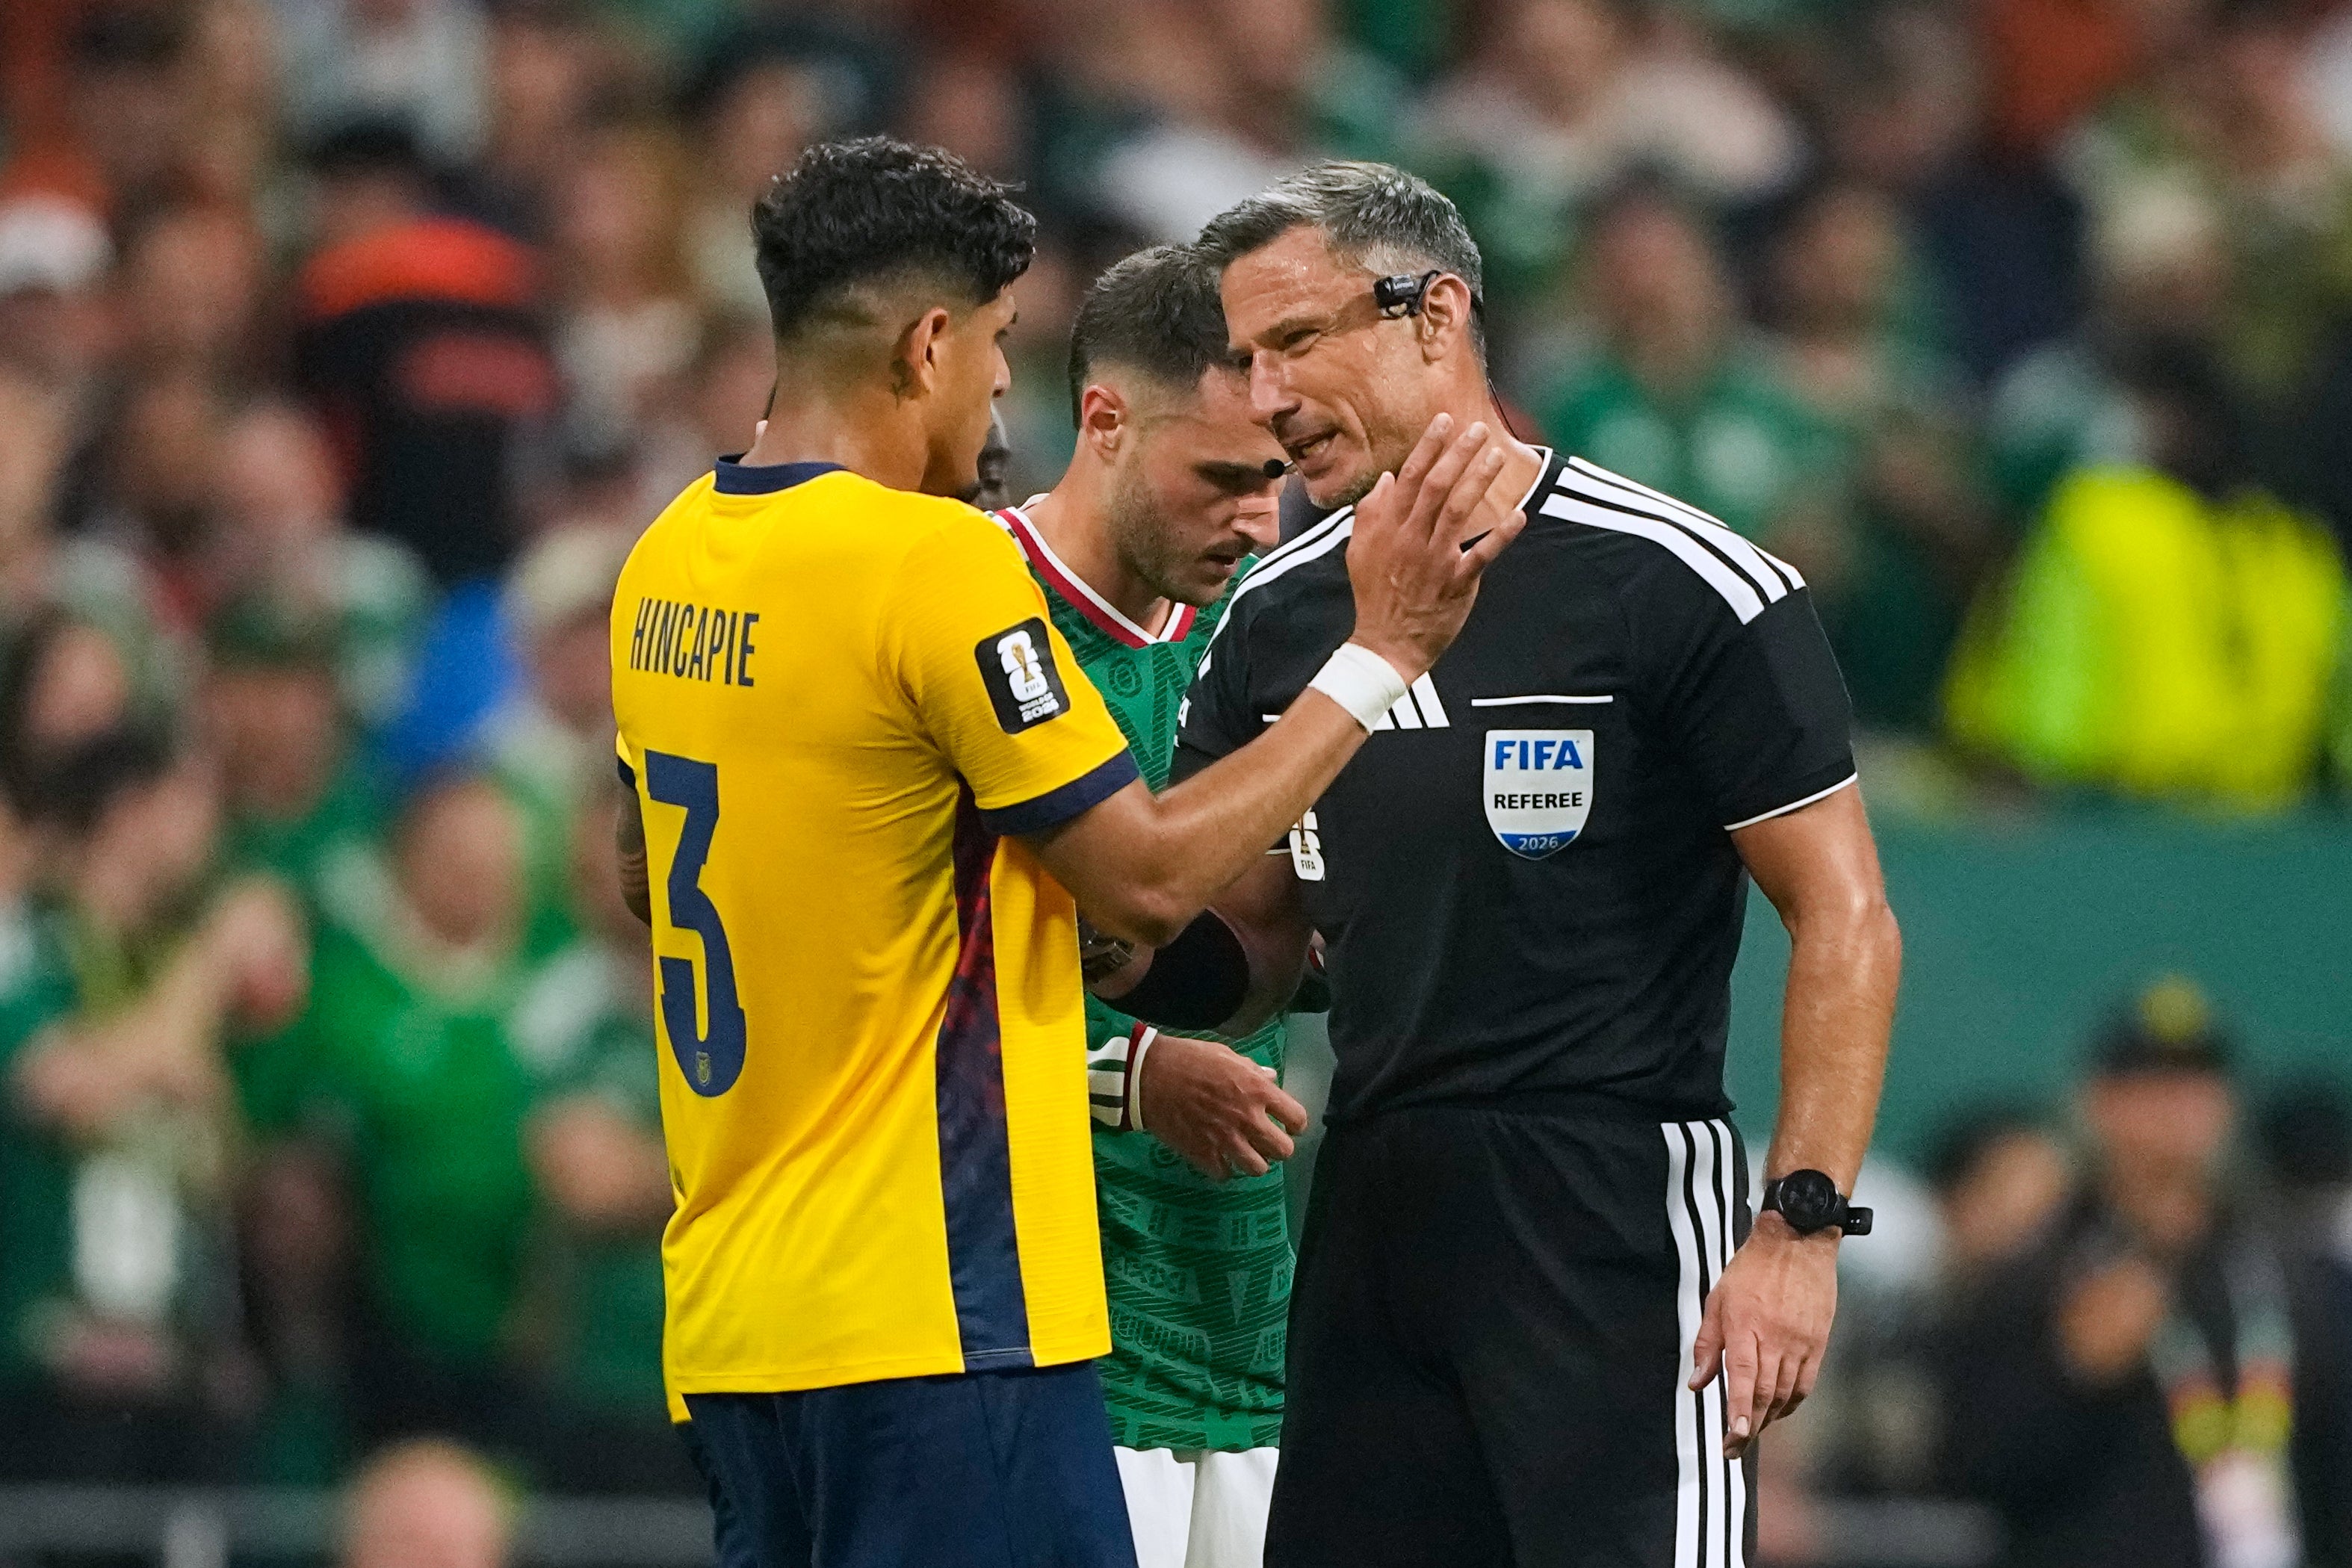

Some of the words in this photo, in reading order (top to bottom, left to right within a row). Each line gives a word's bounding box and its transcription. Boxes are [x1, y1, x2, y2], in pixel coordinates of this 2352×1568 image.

[631, 597, 759, 687] HINCAPIE
[1495, 740, 1583, 770] FIFA
[1494, 793, 1582, 809] REFEREE
[1518, 836, 1559, 850] 2026
[1301, 860, 1316, 870] FIFA
[644, 749, 746, 1097] 3
